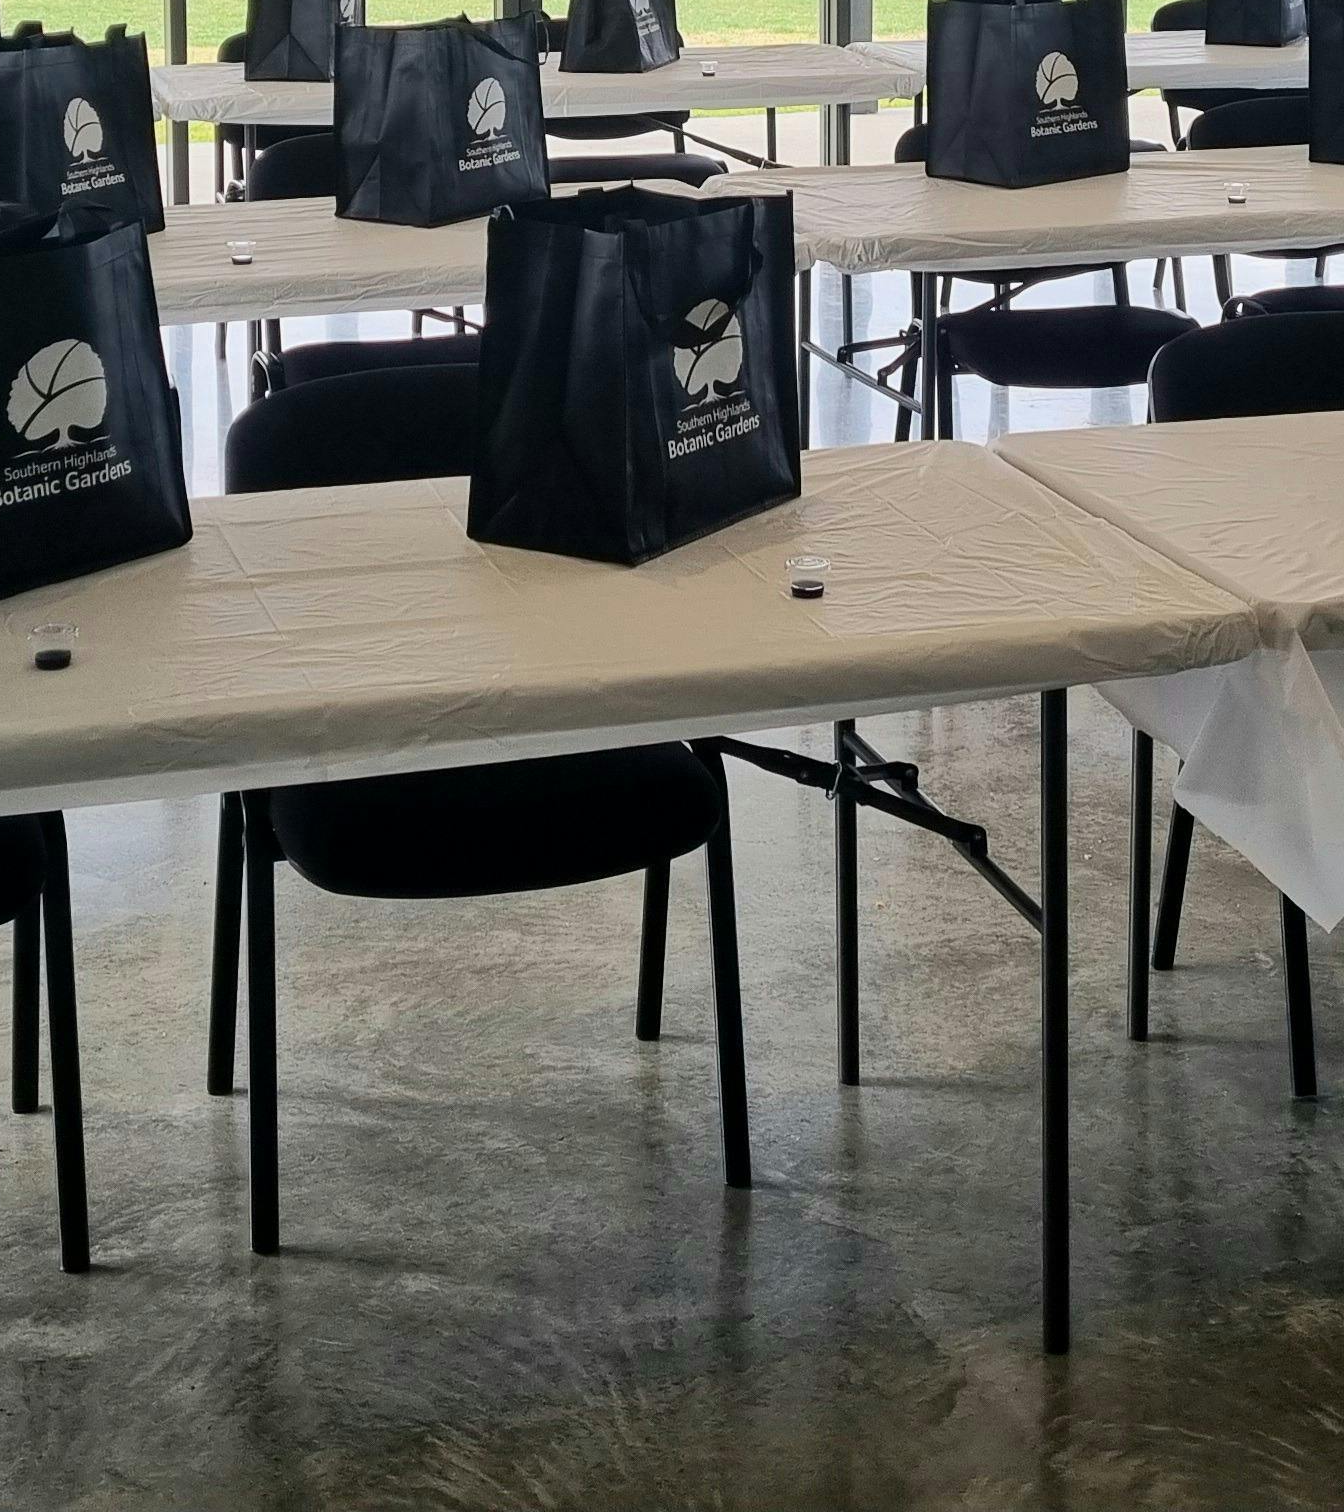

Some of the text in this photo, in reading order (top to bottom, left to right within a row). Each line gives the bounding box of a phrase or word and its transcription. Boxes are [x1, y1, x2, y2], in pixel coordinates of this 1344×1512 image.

[1063, 119, 1098, 133] Gardens
[458, 154, 492, 172] Botanic
[91, 173, 126, 189] Gardens
[676, 398, 751, 435] Southern Highlands
[667, 414, 761, 460] Botanic Gardens
[3, 460, 61, 482] Southern
[65, 459, 132, 491] Gardens
